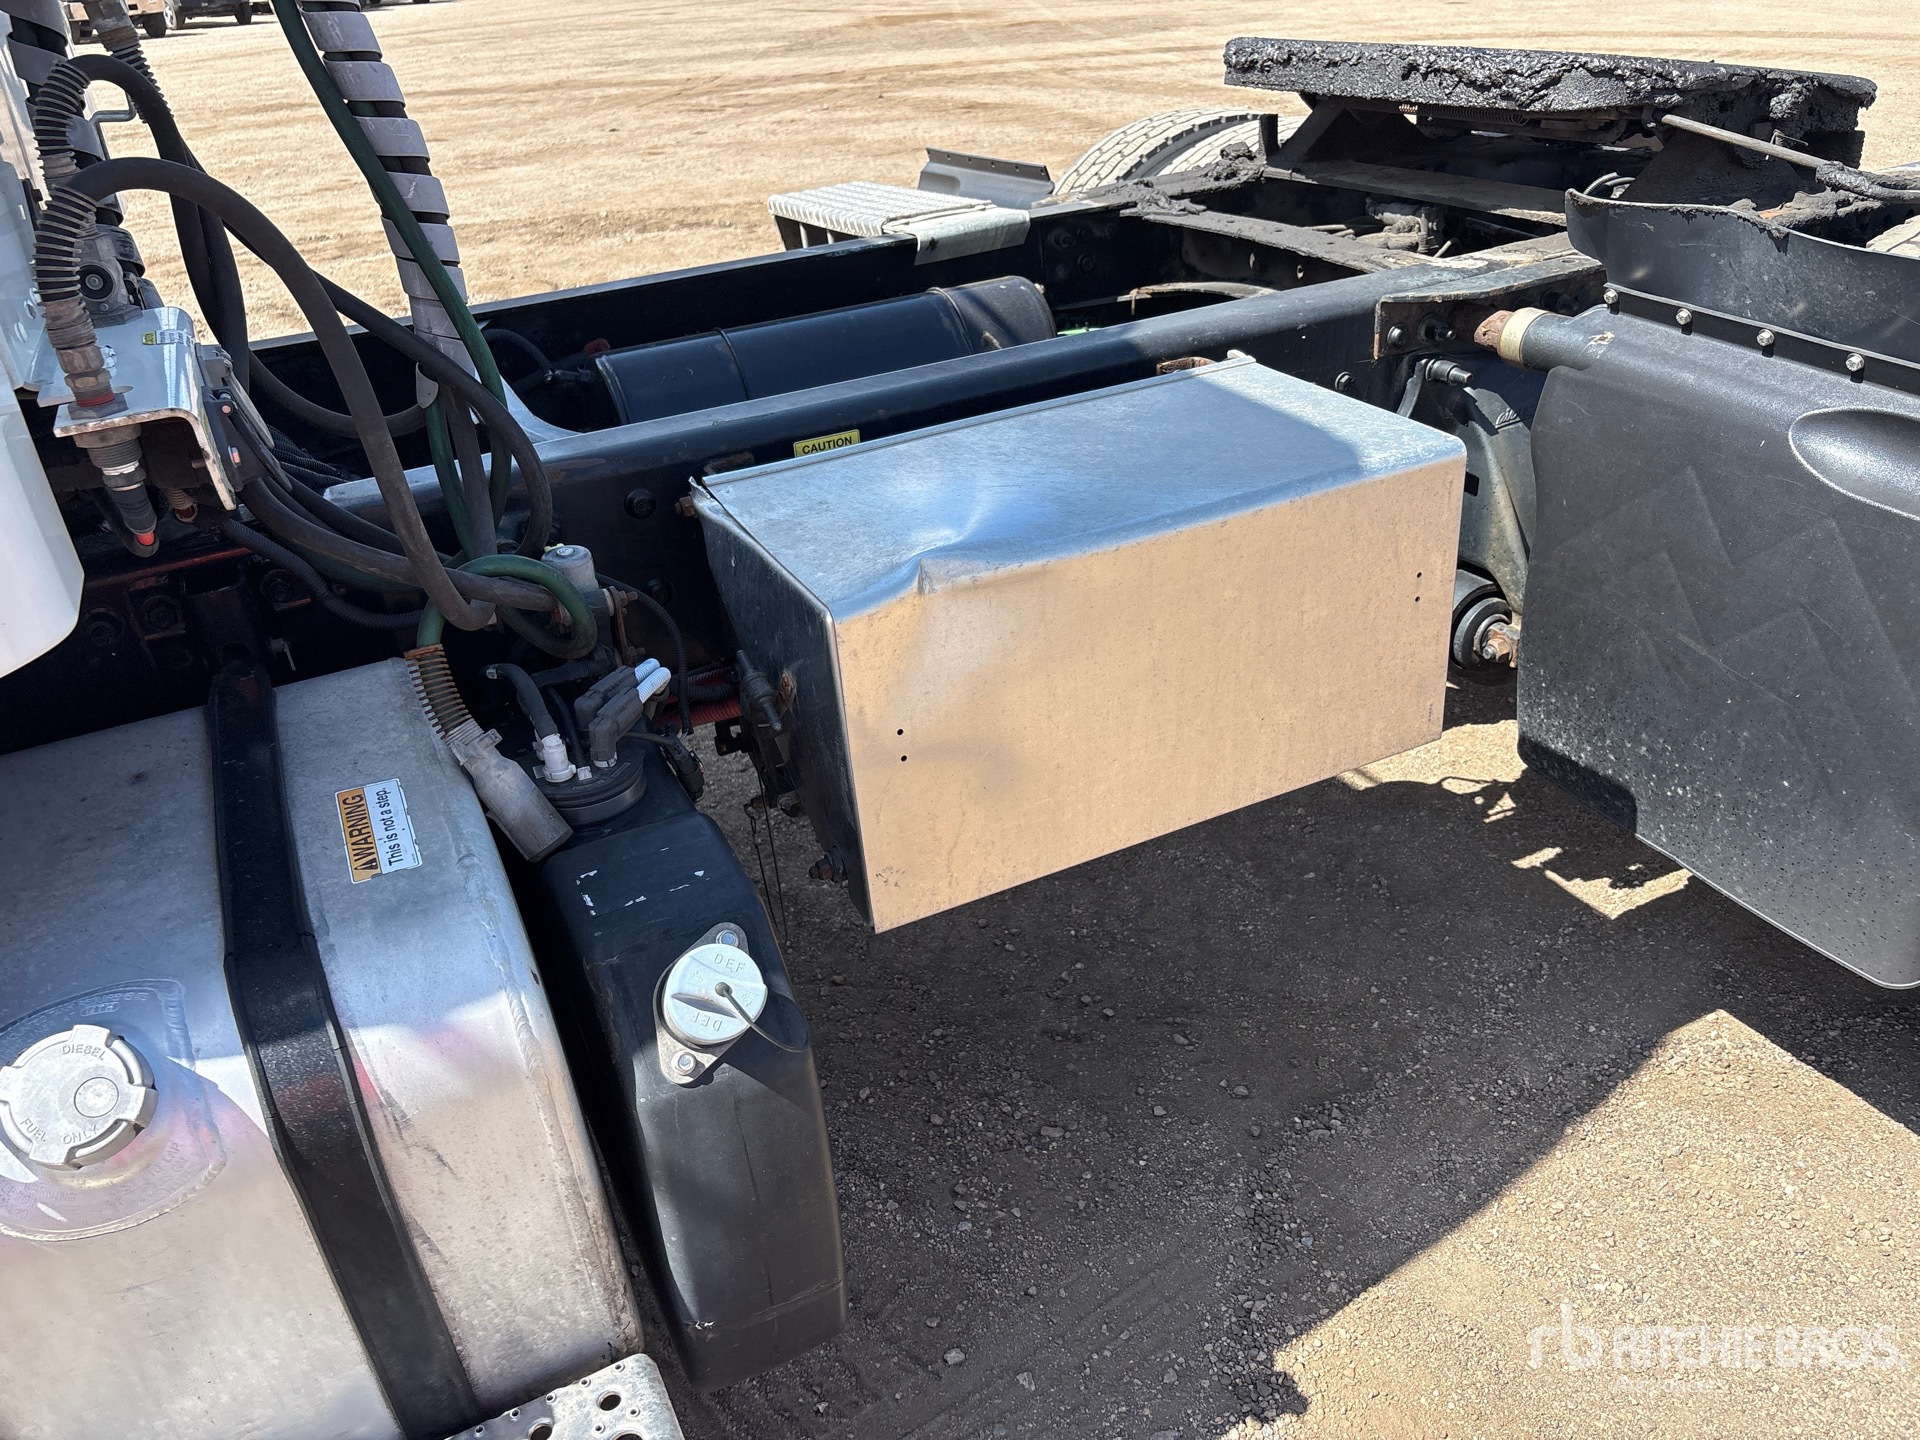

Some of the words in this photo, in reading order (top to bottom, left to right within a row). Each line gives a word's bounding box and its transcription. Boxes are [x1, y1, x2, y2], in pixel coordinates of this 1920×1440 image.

[802, 436, 852, 454] CAUTION
[375, 787, 391, 808] step.
[342, 793, 376, 862] WARNING
[379, 815, 396, 832] not
[383, 832, 398, 843] is
[386, 843, 404, 866] This
[713, 953, 746, 973] DEF
[690, 1012, 723, 1032] DEF
[62, 1043, 106, 1061] DIESEL
[20, 1117, 48, 1143] FUEL
[62, 1124, 99, 1145] ONLY
